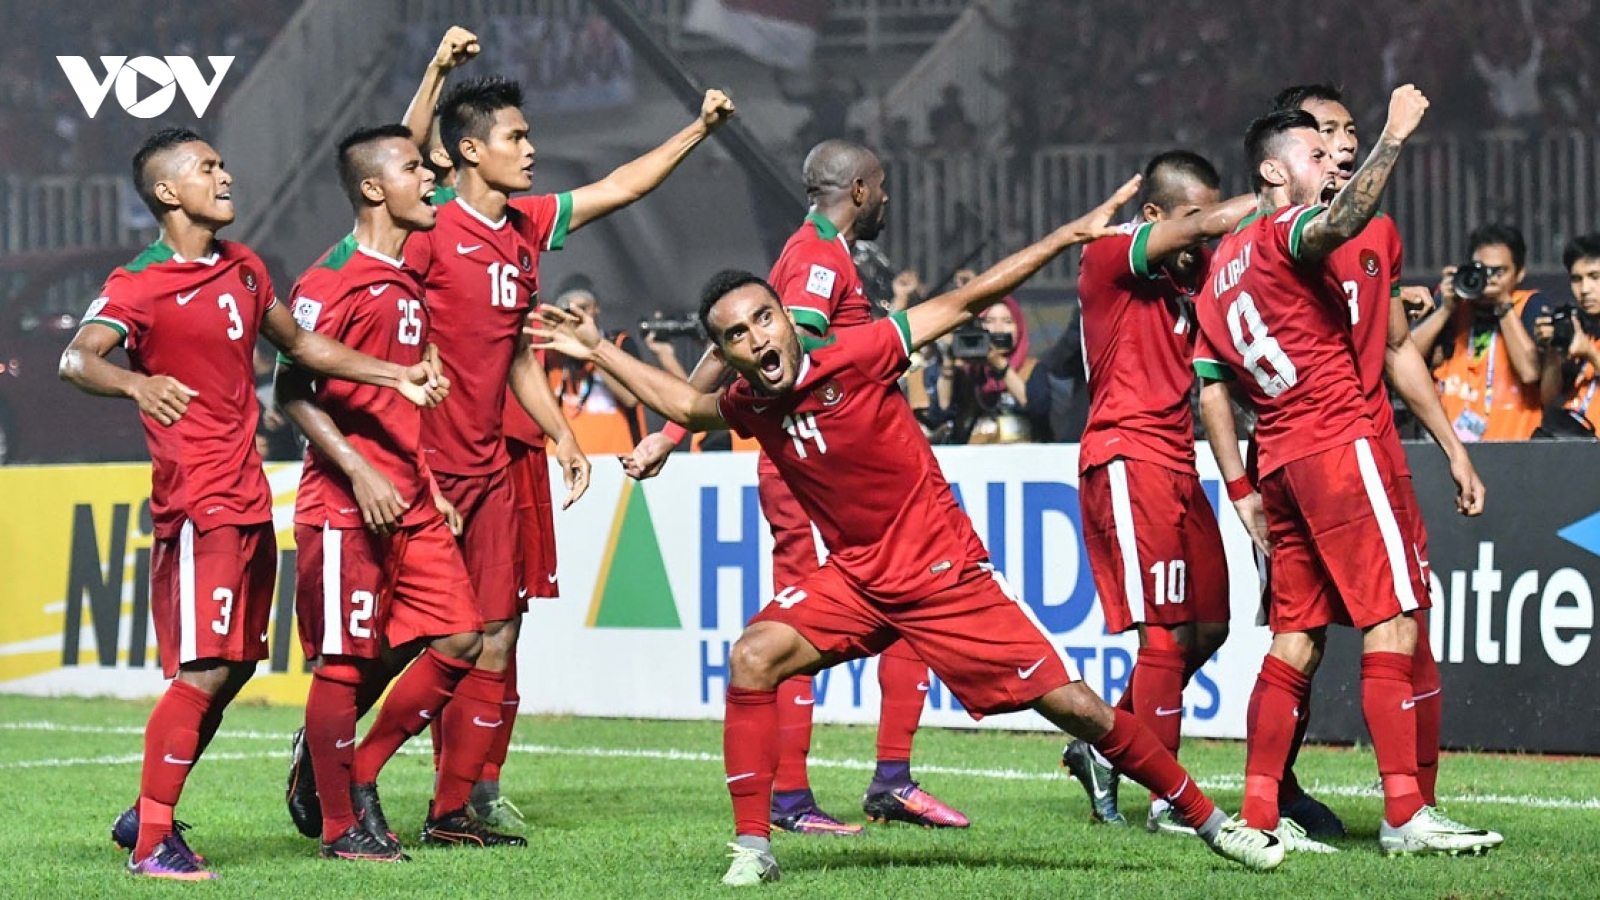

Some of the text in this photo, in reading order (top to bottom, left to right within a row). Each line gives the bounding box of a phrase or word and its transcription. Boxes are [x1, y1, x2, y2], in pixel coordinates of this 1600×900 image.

[487, 262, 519, 308] 16
[218, 293, 244, 340] 3
[398, 298, 422, 345] 25
[1227, 290, 1297, 397] 8
[781, 411, 827, 459] 14
[1150, 559, 1187, 605] 10
[211, 586, 234, 635] 3
[350, 589, 379, 639] 2
